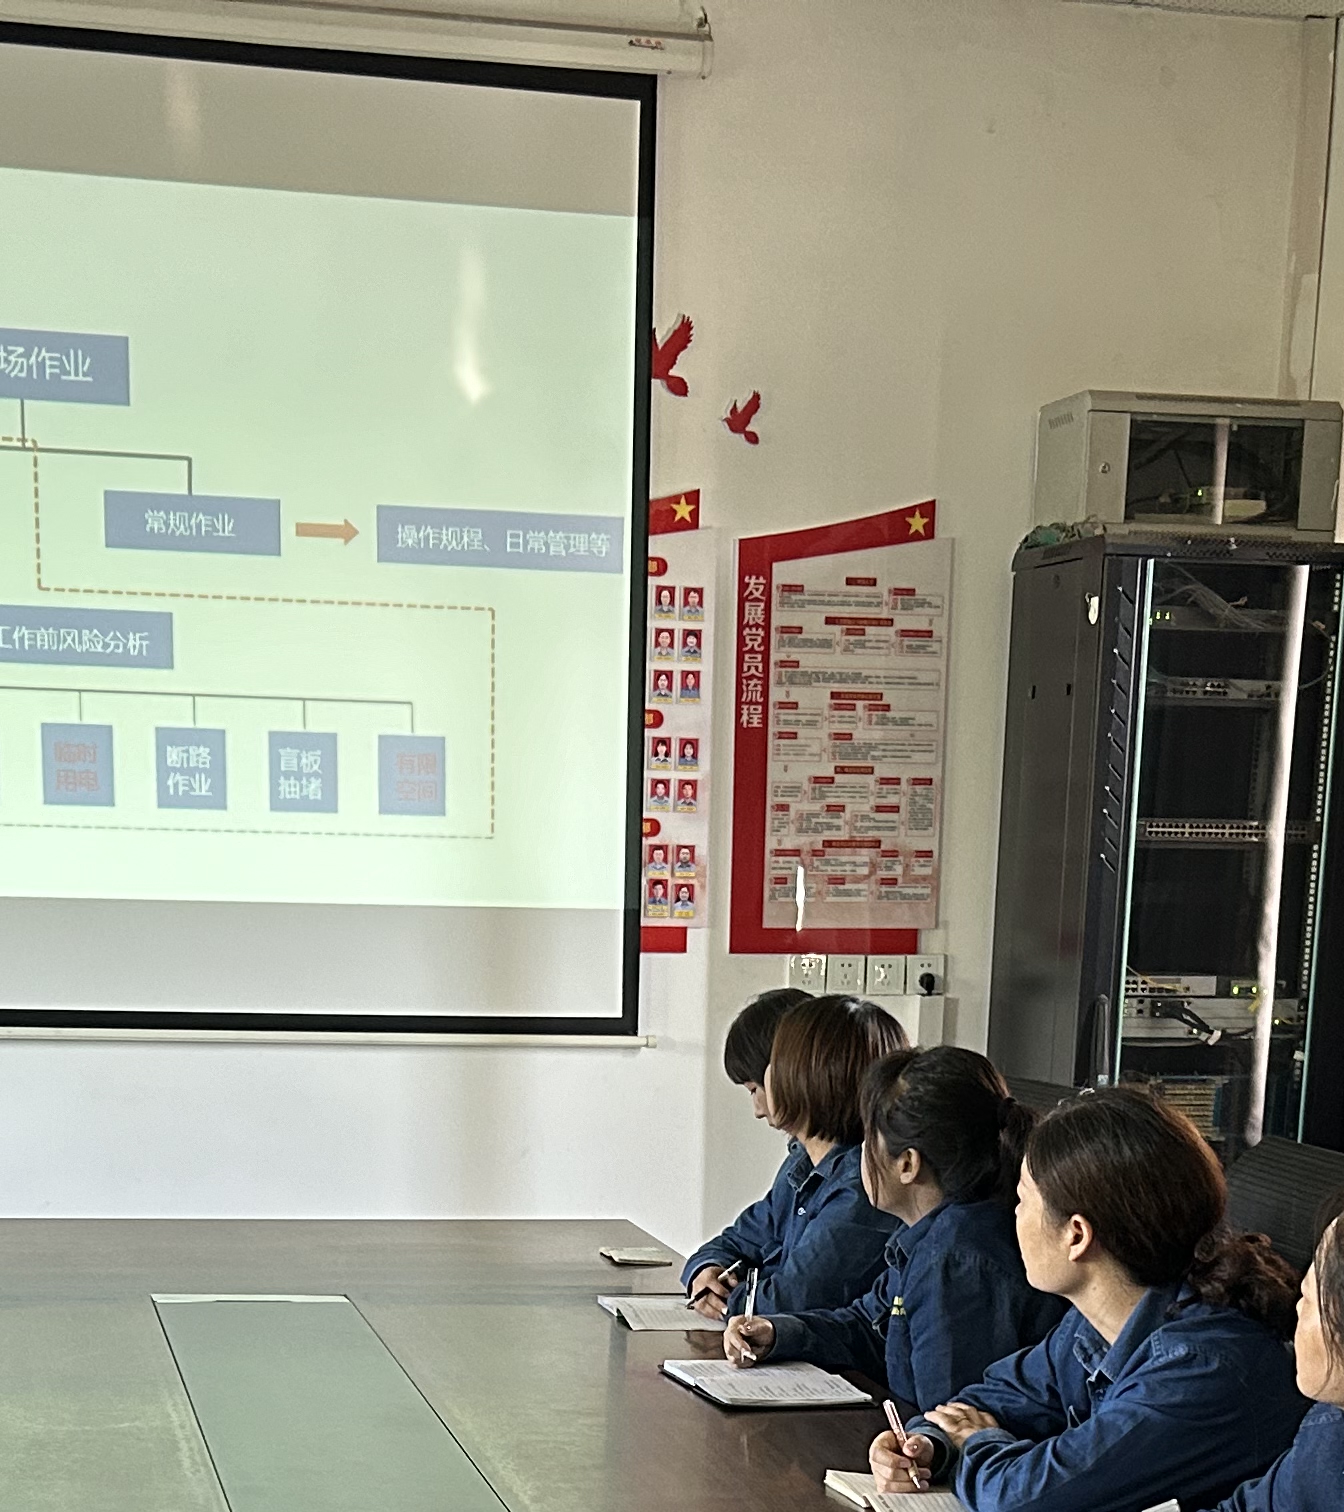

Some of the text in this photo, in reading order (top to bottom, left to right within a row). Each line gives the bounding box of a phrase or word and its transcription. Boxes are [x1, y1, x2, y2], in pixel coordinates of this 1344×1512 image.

[143, 509, 236, 538] 常规作业
[395, 525, 612, 558] 操作规程、日常管理等
[739, 574, 765, 730] 发展党员流程
[53, 741, 97, 765] 临时
[166, 745, 211, 769] 断路
[278, 748, 322, 774] 盲板
[55, 769, 100, 792] 用电
[166, 772, 213, 796] 作业
[278, 775, 323, 800] 抽堵
